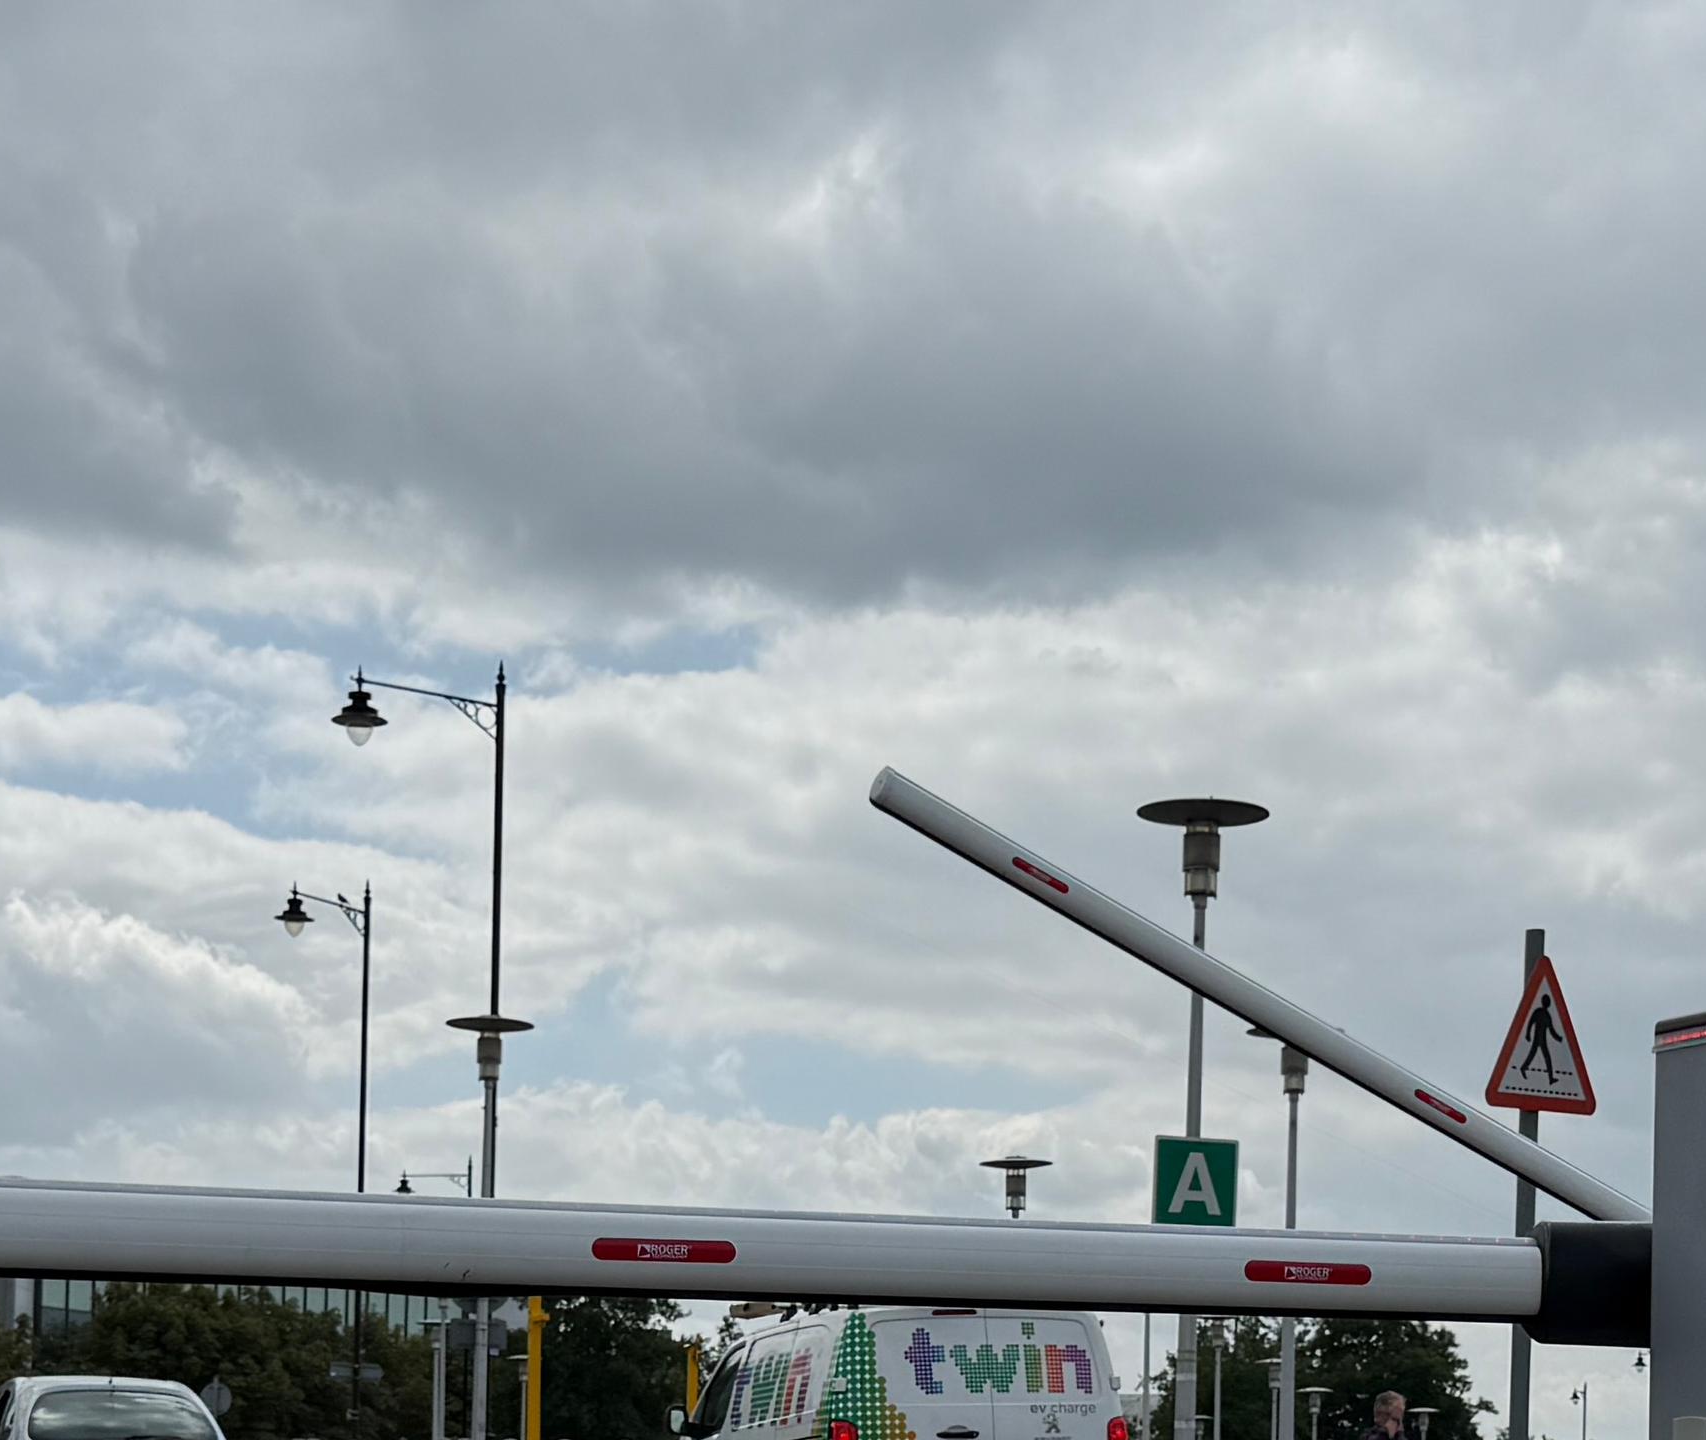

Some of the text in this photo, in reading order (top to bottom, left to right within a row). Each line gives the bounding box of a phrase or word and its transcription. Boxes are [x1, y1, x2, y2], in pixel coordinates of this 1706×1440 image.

[1167, 1151, 1222, 1216] A
[650, 1244, 689, 1256] ROGER
[1296, 1266, 1330, 1277] ROGER
[904, 1322, 1093, 1395] twin
[731, 1348, 813, 1432] twin
[1030, 1403, 1097, 1416] ev charge
